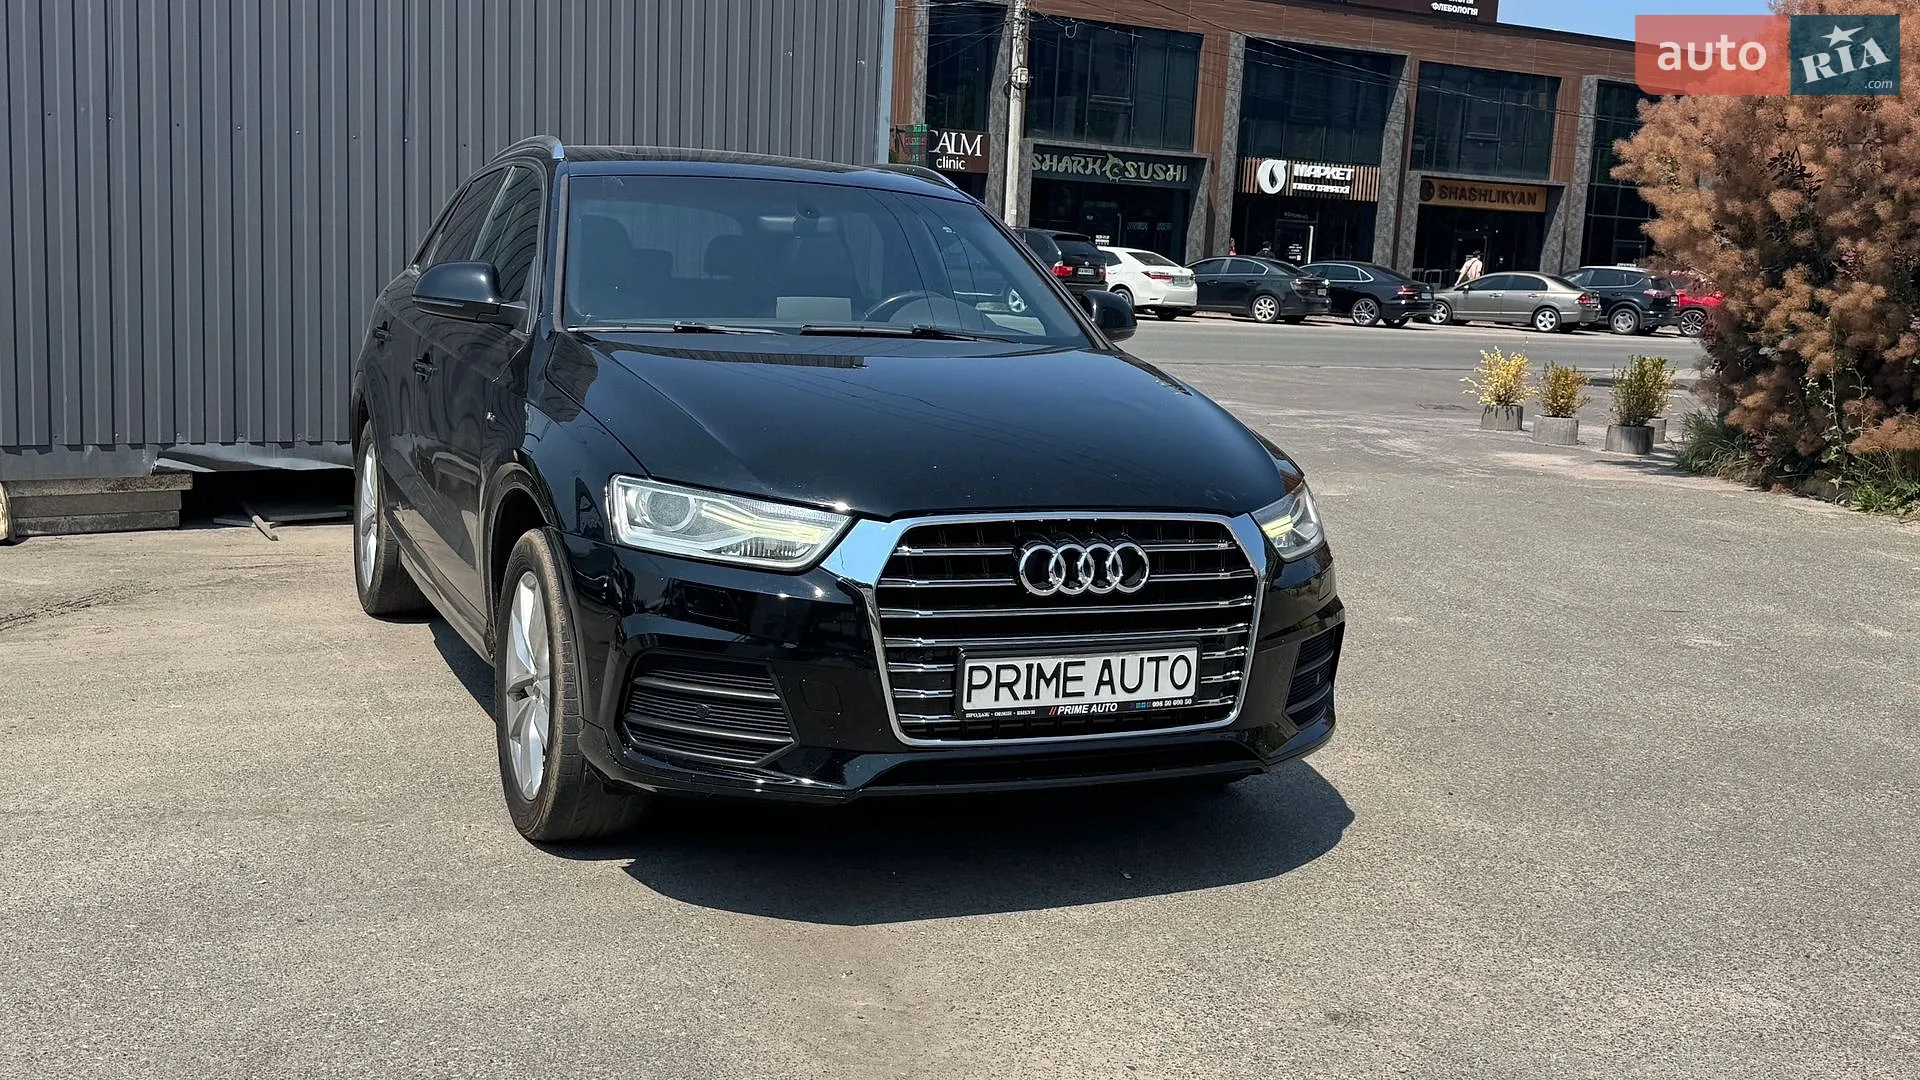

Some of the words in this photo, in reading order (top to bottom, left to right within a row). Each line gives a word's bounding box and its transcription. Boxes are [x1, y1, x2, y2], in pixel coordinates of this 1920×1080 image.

[935, 155, 966, 170] clinic
[1031, 152, 1102, 175] SHARK
[1124, 160, 1188, 182] SUSHI
[1438, 185, 1537, 206] SHASHLIKYAN
[967, 661, 1085, 703] PRIME
[1094, 655, 1192, 696] AUTO
[1057, 704, 1090, 716] PRIME
[1090, 703, 1118, 714] AUTO
